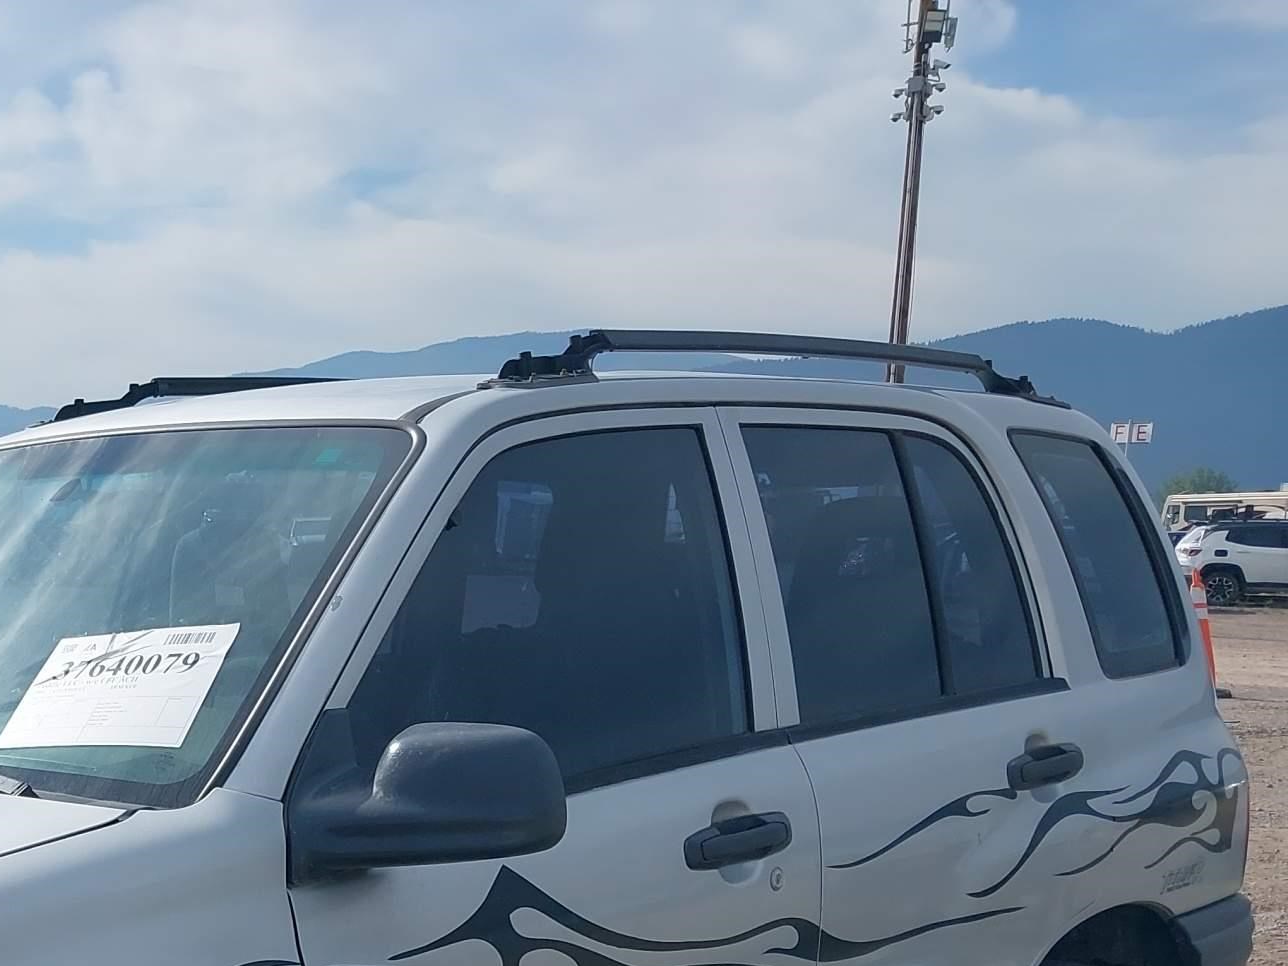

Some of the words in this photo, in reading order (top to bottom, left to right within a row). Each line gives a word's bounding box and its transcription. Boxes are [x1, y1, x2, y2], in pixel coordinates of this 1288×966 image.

[1114, 424, 1125, 441] F
[1136, 424, 1148, 441] E
[56, 651, 201, 679] 37640079
